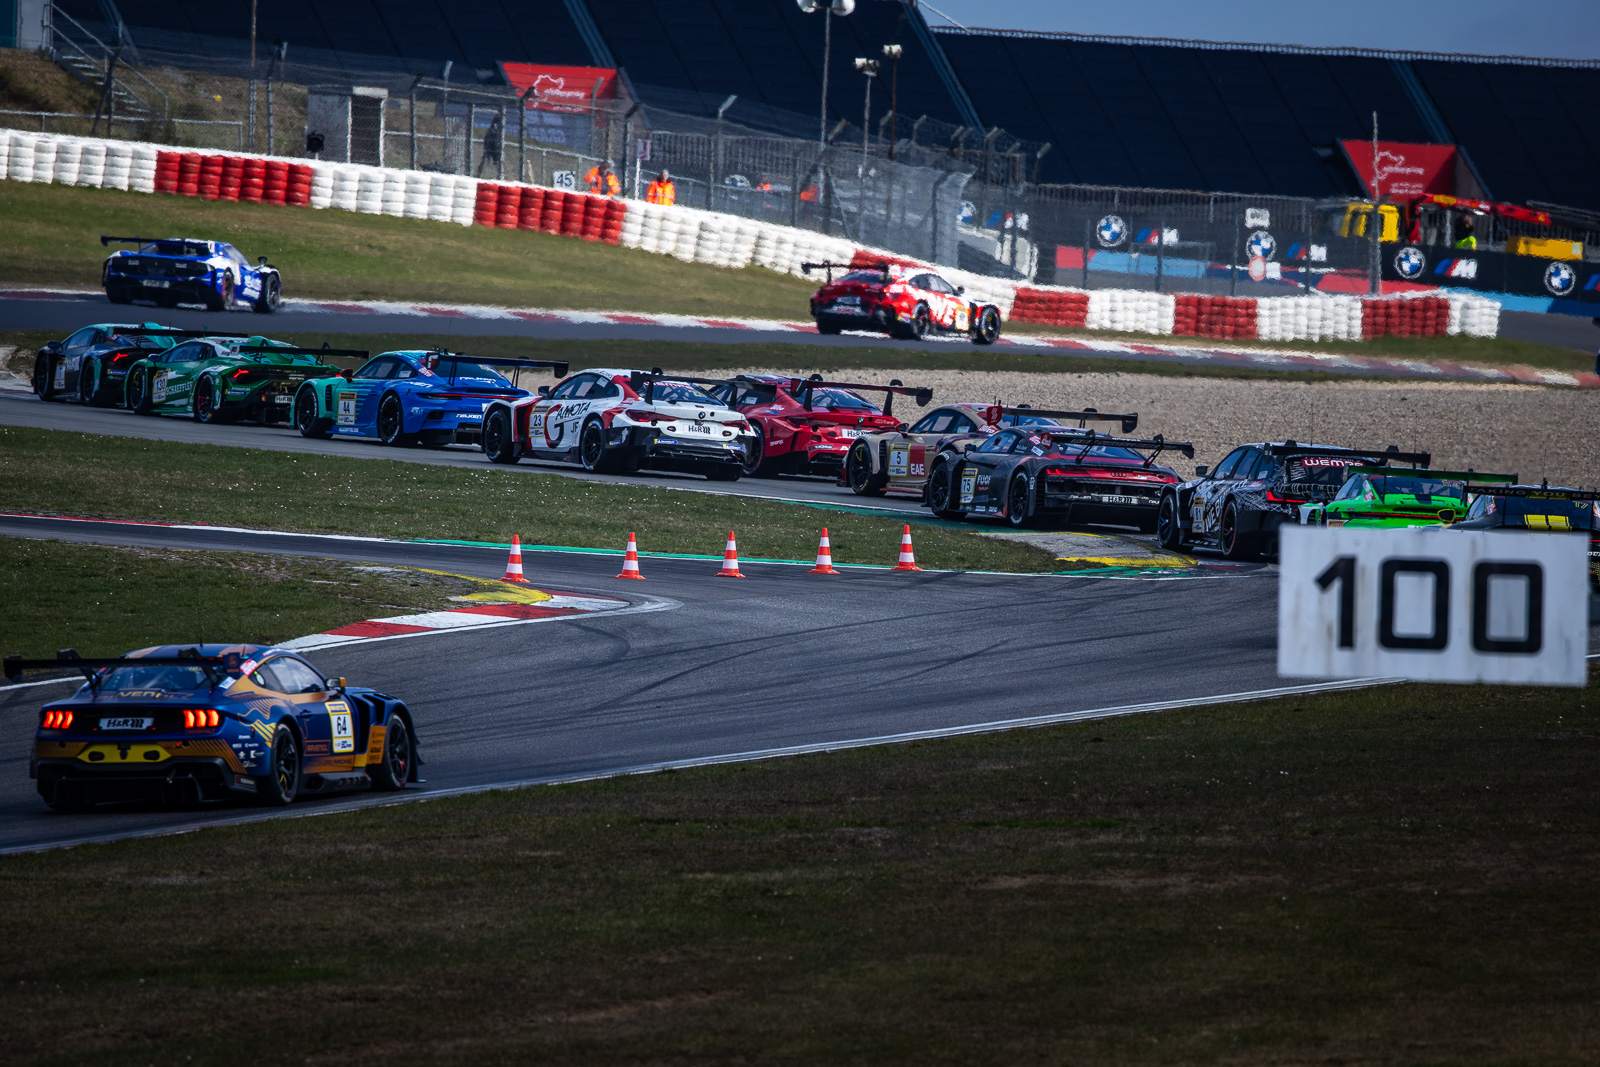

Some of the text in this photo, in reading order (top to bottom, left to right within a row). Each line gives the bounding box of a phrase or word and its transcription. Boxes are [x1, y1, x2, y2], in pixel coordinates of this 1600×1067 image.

[556, 172, 573, 188] 45
[156, 379, 166, 392] 130
[166, 380, 193, 396] SCHAEFFLER
[343, 401, 350, 414] 44
[533, 415, 542, 427] 23
[896, 451, 901, 465] 5
[910, 463, 925, 476] EAE
[963, 479, 971, 492] 75
[1470, 487, 1527, 496] TAKING
[1532, 490, 1566, 498] YOU
[1314, 555, 1544, 654] 100
[337, 716, 347, 735] 64
